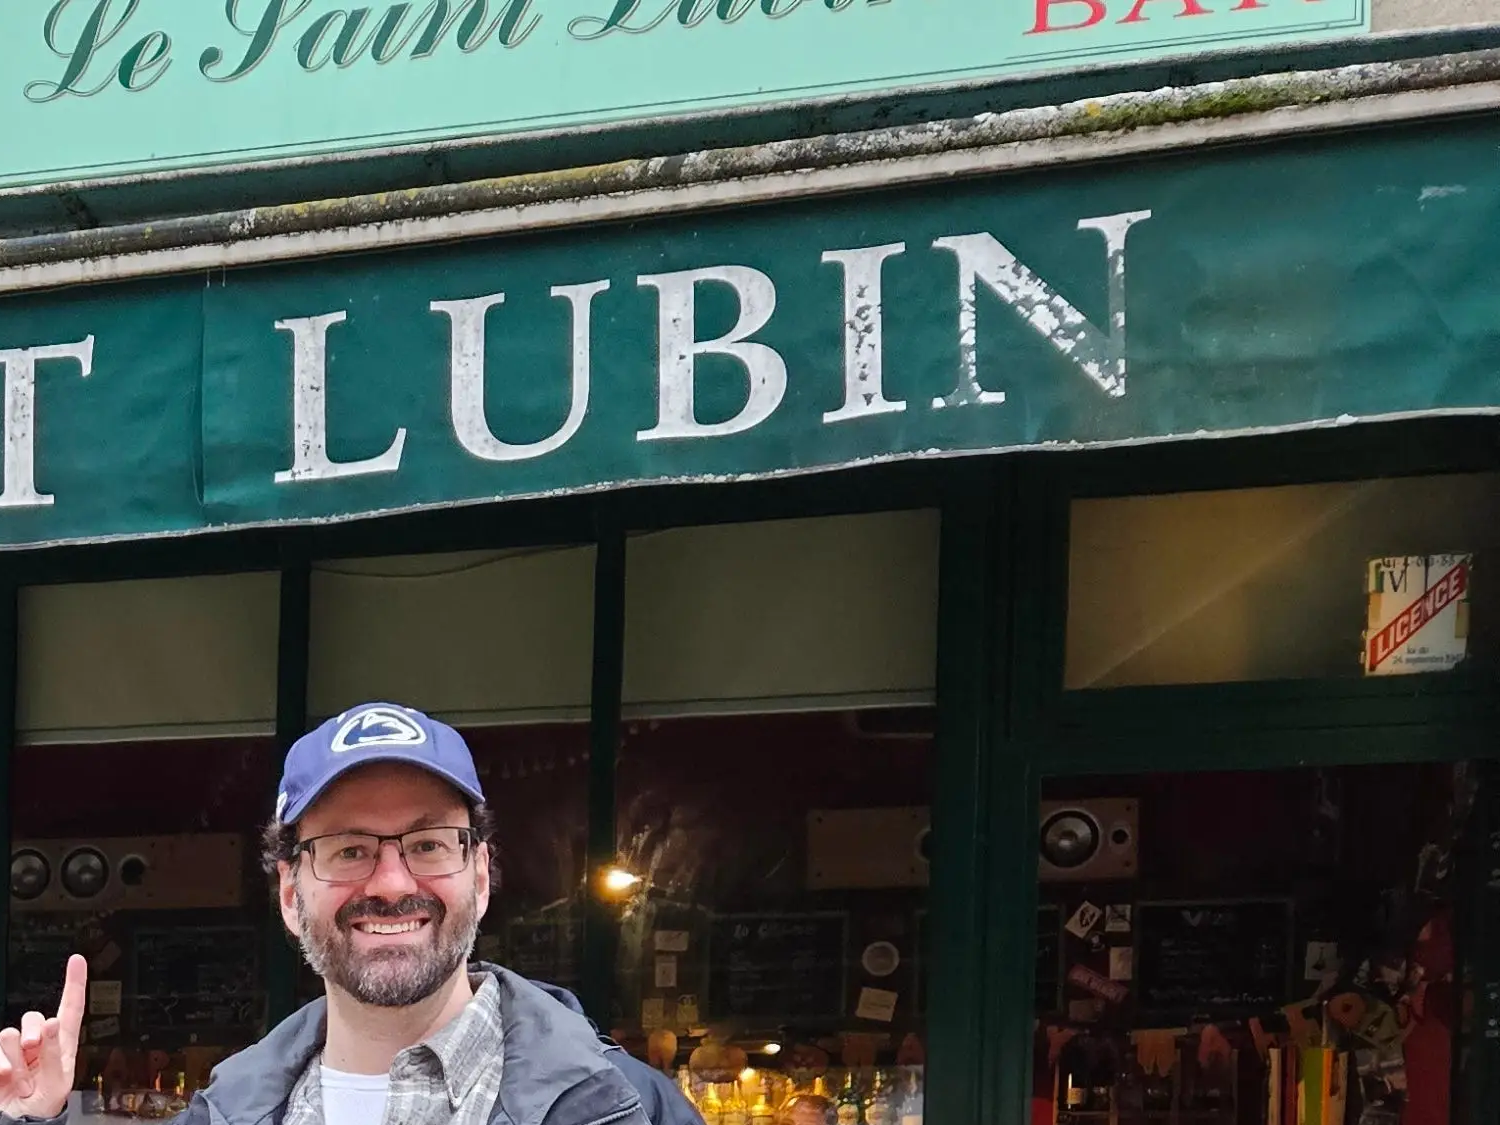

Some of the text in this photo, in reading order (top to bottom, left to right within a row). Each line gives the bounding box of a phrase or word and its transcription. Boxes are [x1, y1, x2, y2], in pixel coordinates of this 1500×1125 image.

[23, 0, 173, 103] Le
[274, 208, 1153, 483] LUBIN
[1376, 565, 1463, 661] LICENCE
